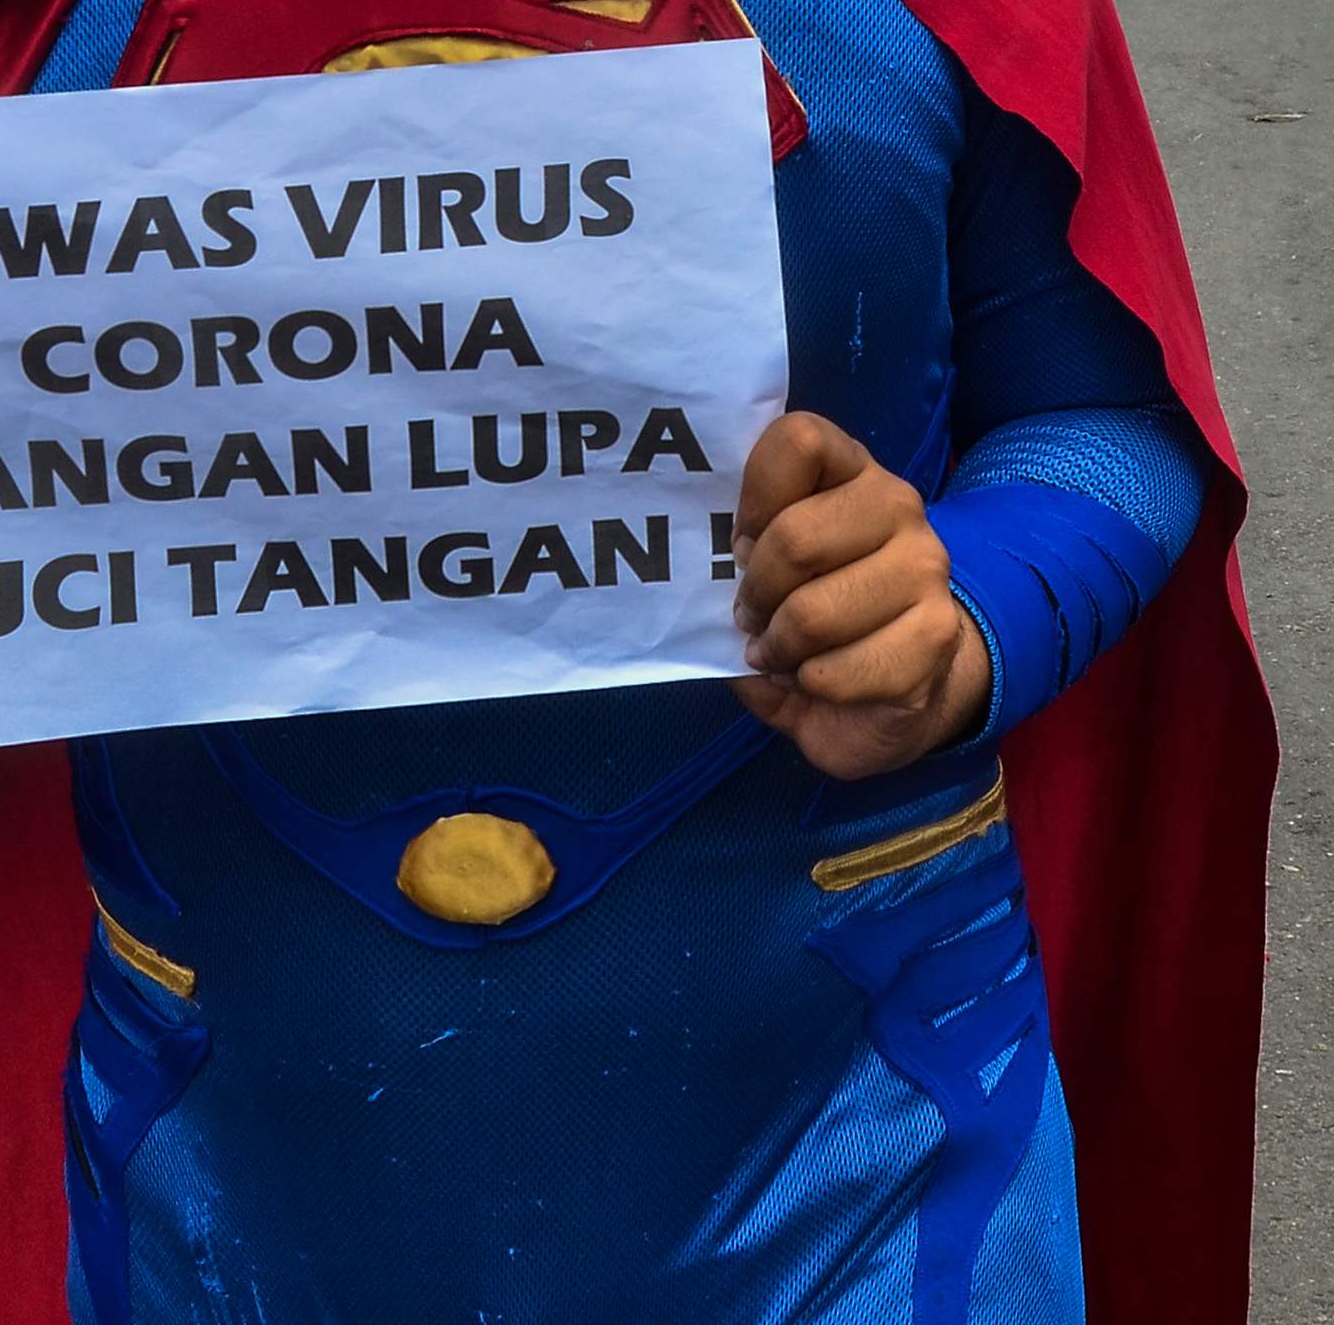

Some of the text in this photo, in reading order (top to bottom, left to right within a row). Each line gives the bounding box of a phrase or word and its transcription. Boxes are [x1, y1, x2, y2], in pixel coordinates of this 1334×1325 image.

[284, 158, 635, 260] VIRUS
[20, 297, 546, 395] CORONA
[407, 406, 715, 491] LUPA
[166, 514, 671, 618] TANGAN
[709, 512, 736, 581] !
